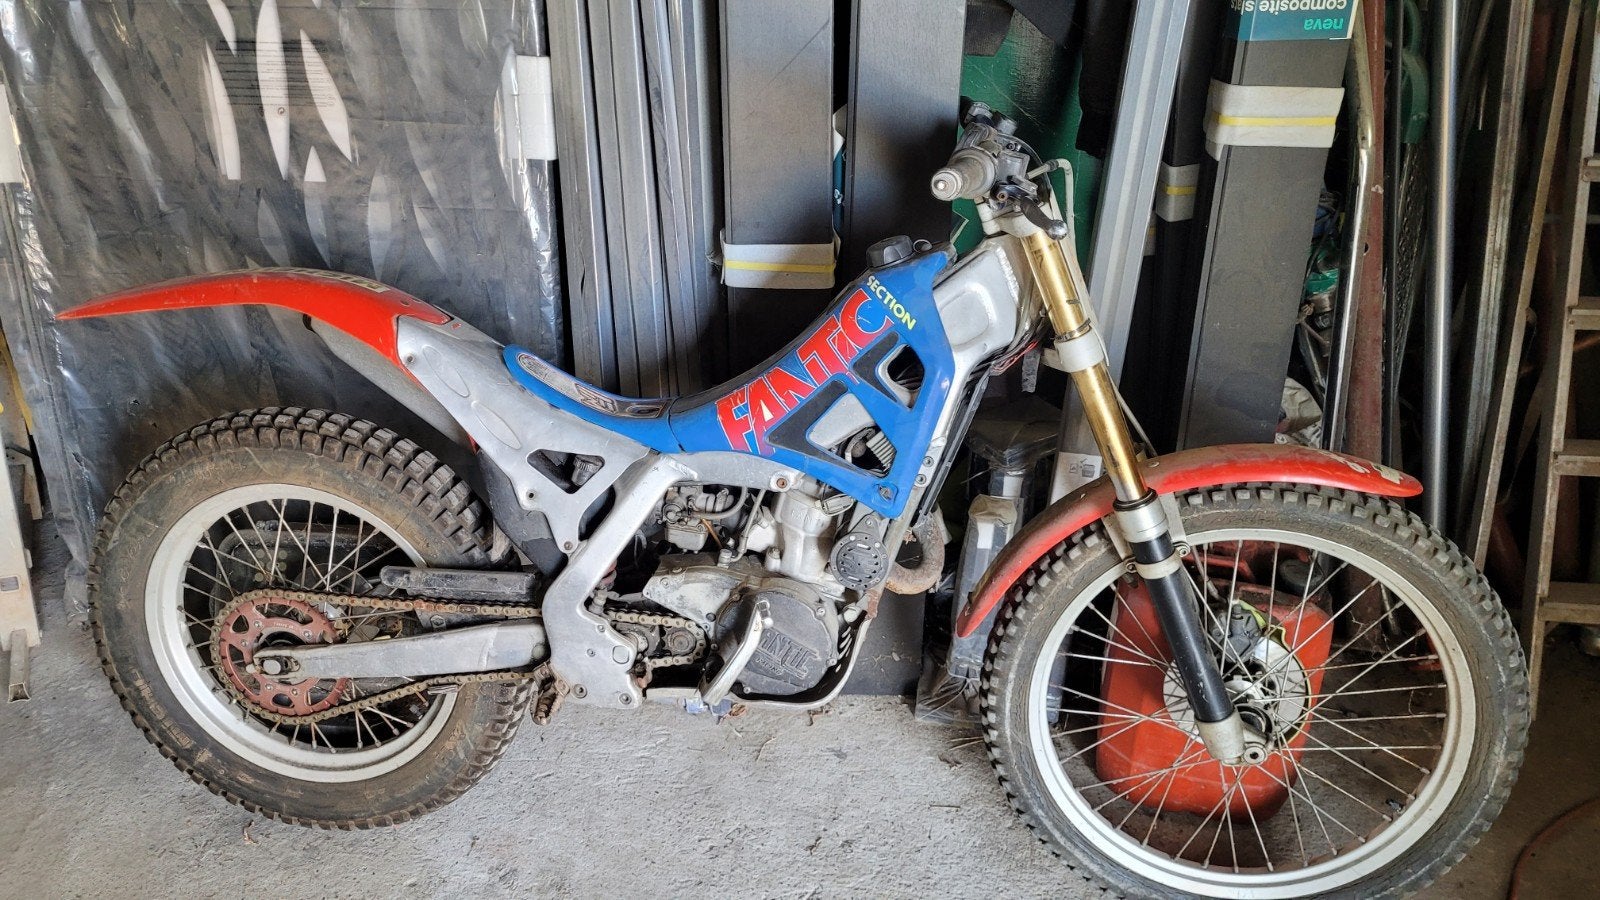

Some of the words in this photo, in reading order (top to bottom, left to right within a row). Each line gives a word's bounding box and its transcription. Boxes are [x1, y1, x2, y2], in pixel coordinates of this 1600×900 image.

[1259, 0, 1347, 15] composite
[1303, 18, 1344, 31] neva
[867, 275, 917, 331] SECTION
[715, 287, 895, 457] FANTIC
